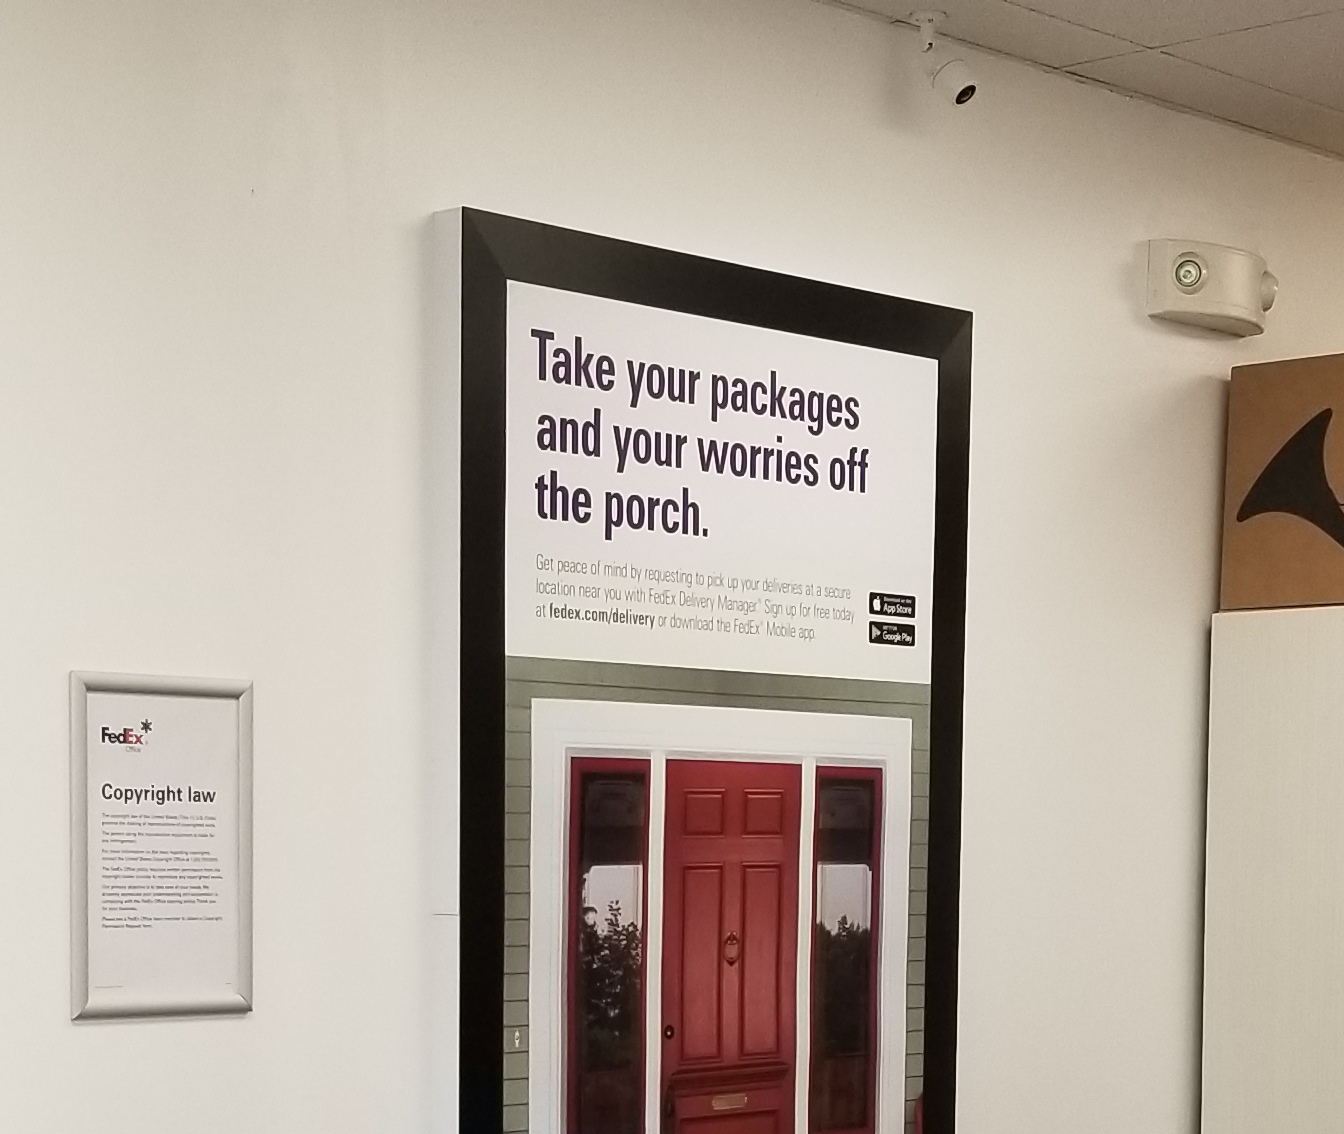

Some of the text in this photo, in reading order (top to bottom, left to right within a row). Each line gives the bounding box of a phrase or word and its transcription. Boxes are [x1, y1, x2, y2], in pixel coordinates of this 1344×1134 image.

[530, 329, 860, 436] Take your packages
[537, 408, 869, 494] and your worries off
[535, 470, 709, 541] the porch.
[536, 553, 851, 600] Get peace of mind by requesting to pick up your deliveries at a secure
[535, 604, 546, 618] at
[549, 602, 655, 630] fedex.com/delivery
[658, 614, 667, 627] or
[670, 613, 714, 632] download
[716, 619, 730, 633] the
[766, 620, 796, 637] Mobile
[536, 577, 576, 597] location
[578, 585, 601, 599] near
[605, 588, 621, 603] you
[624, 588, 646, 603] with
[649, 588, 676, 605] FedEx
[679, 591, 715, 612] Delivery
[764, 598, 783, 616] Sign
[786, 604, 796, 619] up
[799, 604, 811, 618] for
[813, 604, 830, 619] free
[832, 607, 855, 624] today
[101, 726, 144, 745] FedEx
[100, 783, 217, 806] Copyright law
